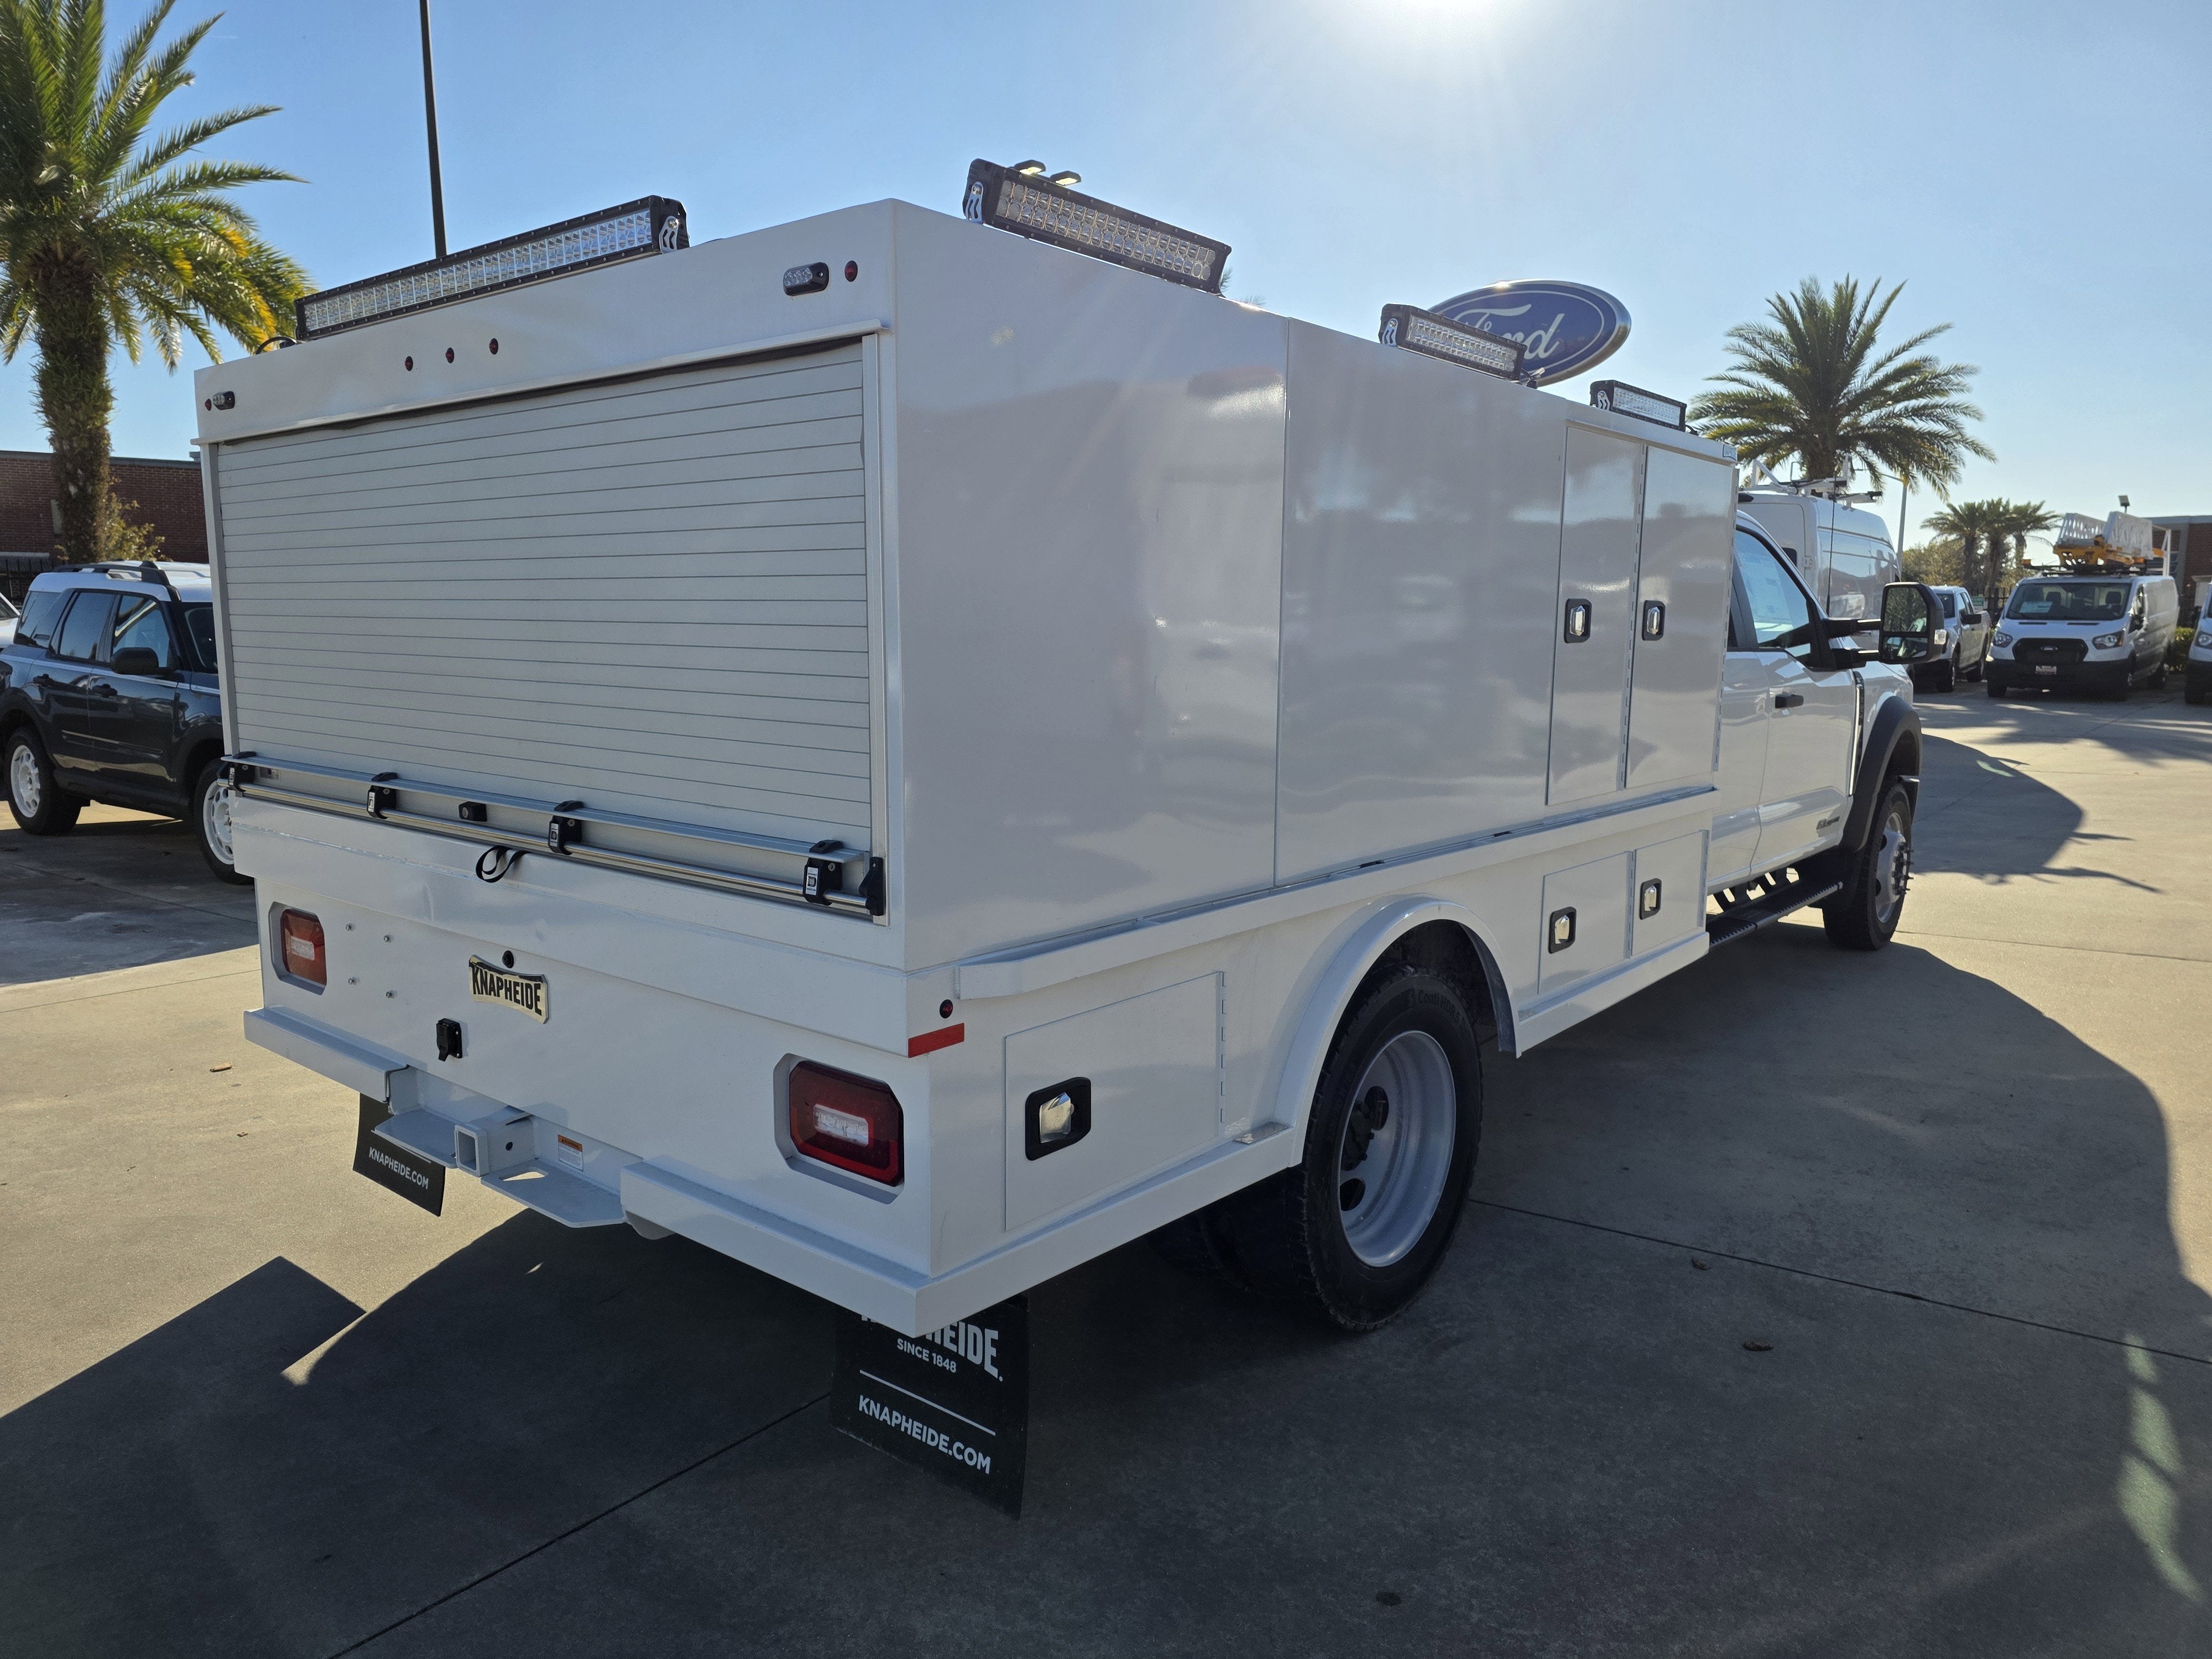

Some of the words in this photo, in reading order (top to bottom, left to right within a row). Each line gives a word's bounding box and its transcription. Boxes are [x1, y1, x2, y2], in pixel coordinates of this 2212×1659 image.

[471, 966, 542, 1016] KNAPHEIDE
[368, 1146, 429, 1190] KNAPHEIDE.COM
[896, 1338, 930, 1362] SINCE
[931, 1353, 957, 1373] 1848
[858, 1395, 991, 1475] KNAPHEIDE.COM
